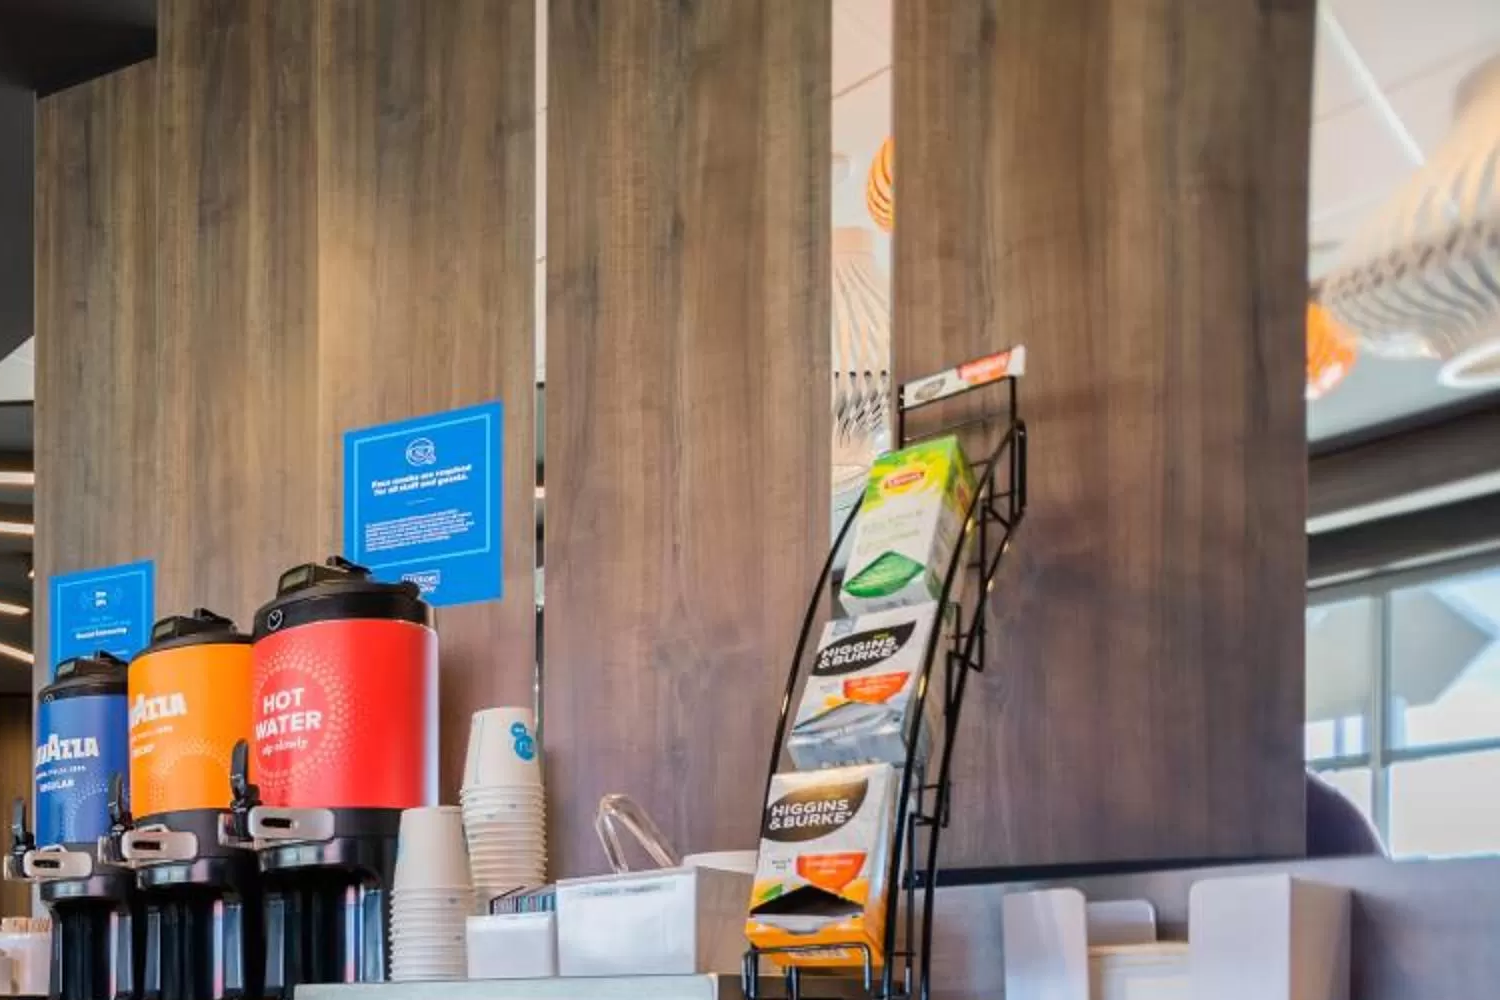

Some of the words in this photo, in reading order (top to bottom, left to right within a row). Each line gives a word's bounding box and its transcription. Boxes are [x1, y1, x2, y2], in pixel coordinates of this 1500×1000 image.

[821, 636, 896, 659] HIGGINS
[263, 687, 305, 716] HOT
[256, 711, 322, 741] WATER
[771, 799, 849, 817] HIGGINS
